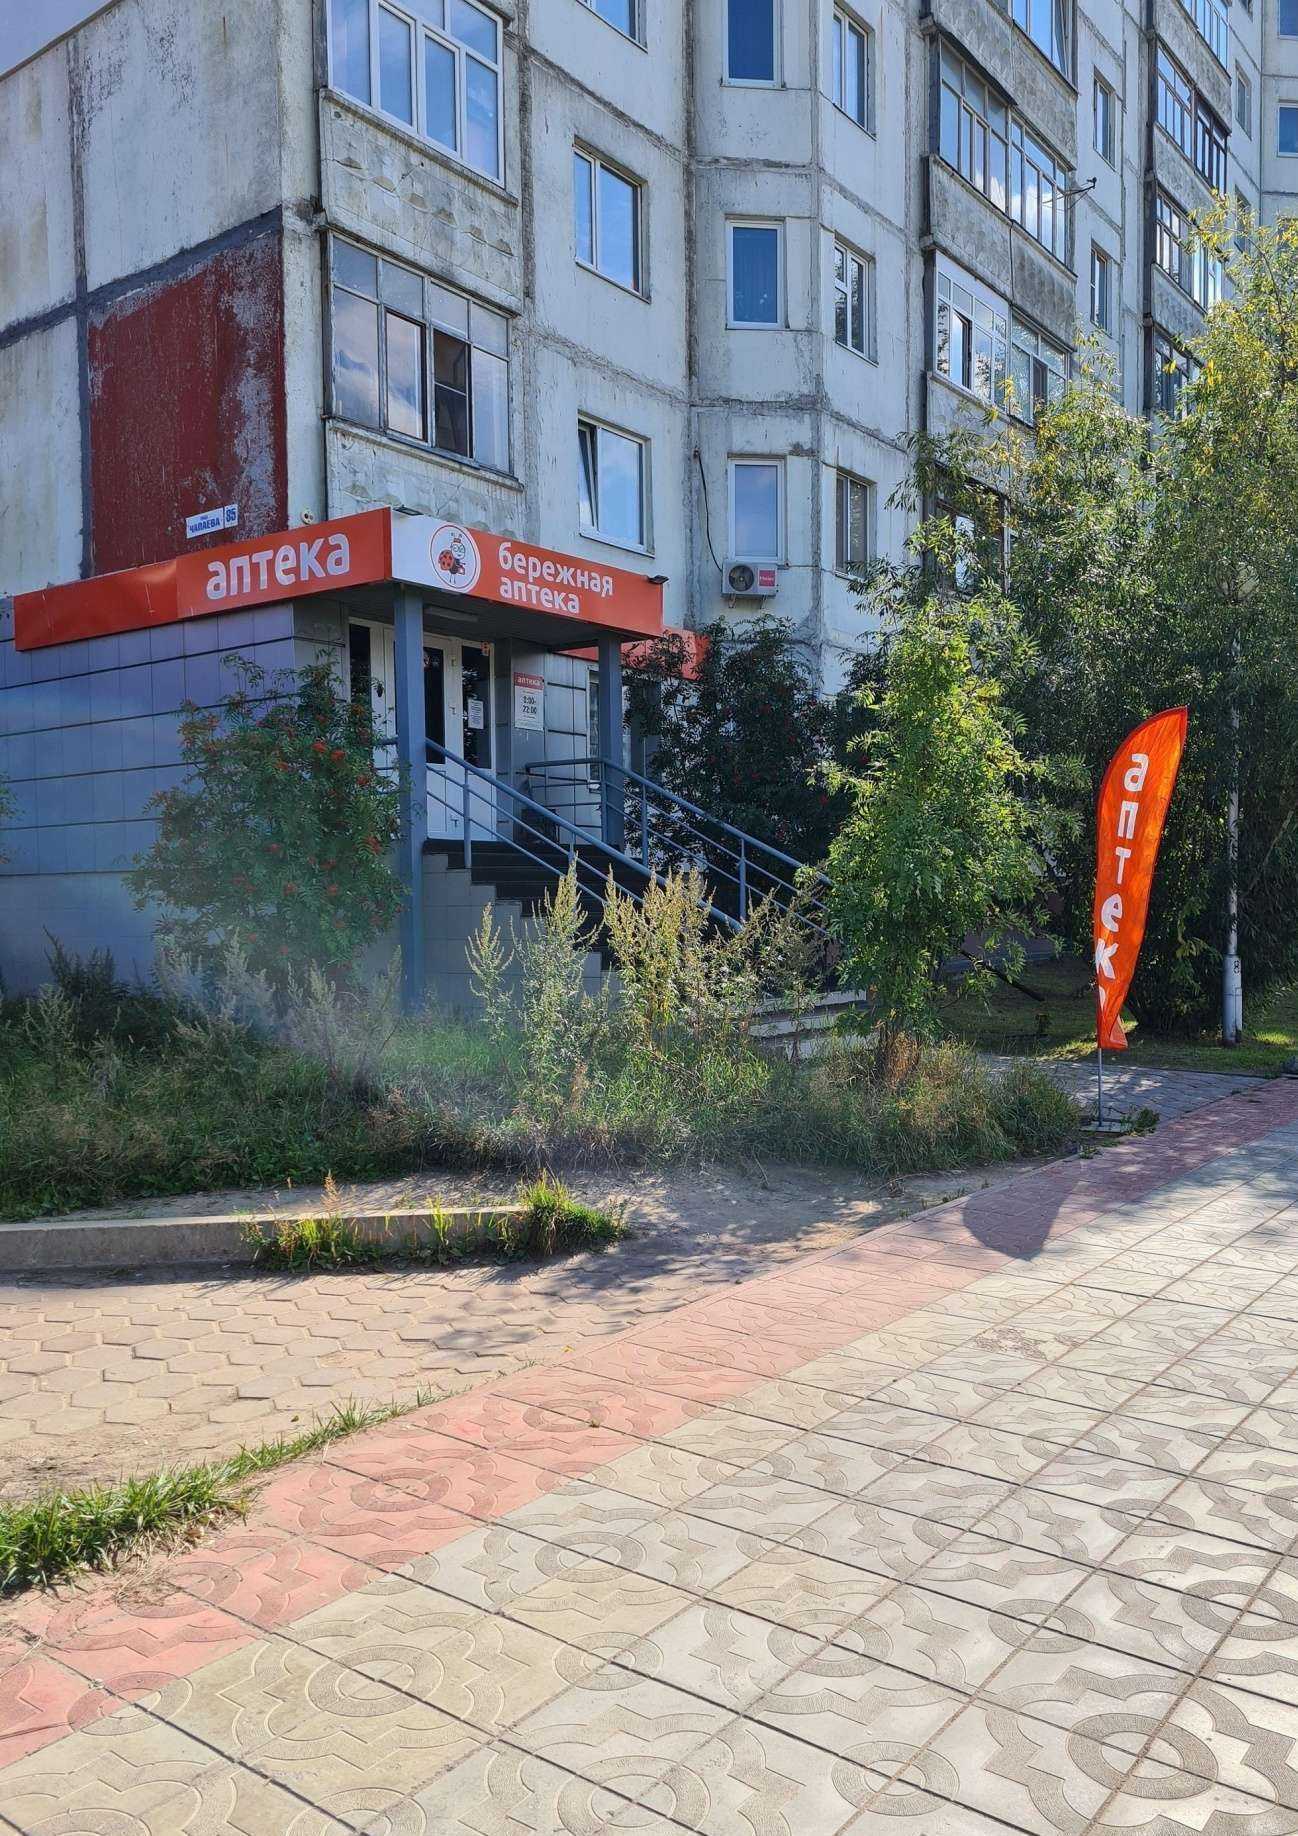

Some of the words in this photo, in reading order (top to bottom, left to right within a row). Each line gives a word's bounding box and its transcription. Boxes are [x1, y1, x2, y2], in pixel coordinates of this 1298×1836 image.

[190, 517, 220, 533] ЧАПАЕВА
[206, 533, 350, 600] аптека
[499, 541, 614, 598] бережная
[500, 576, 581, 614] аптека
